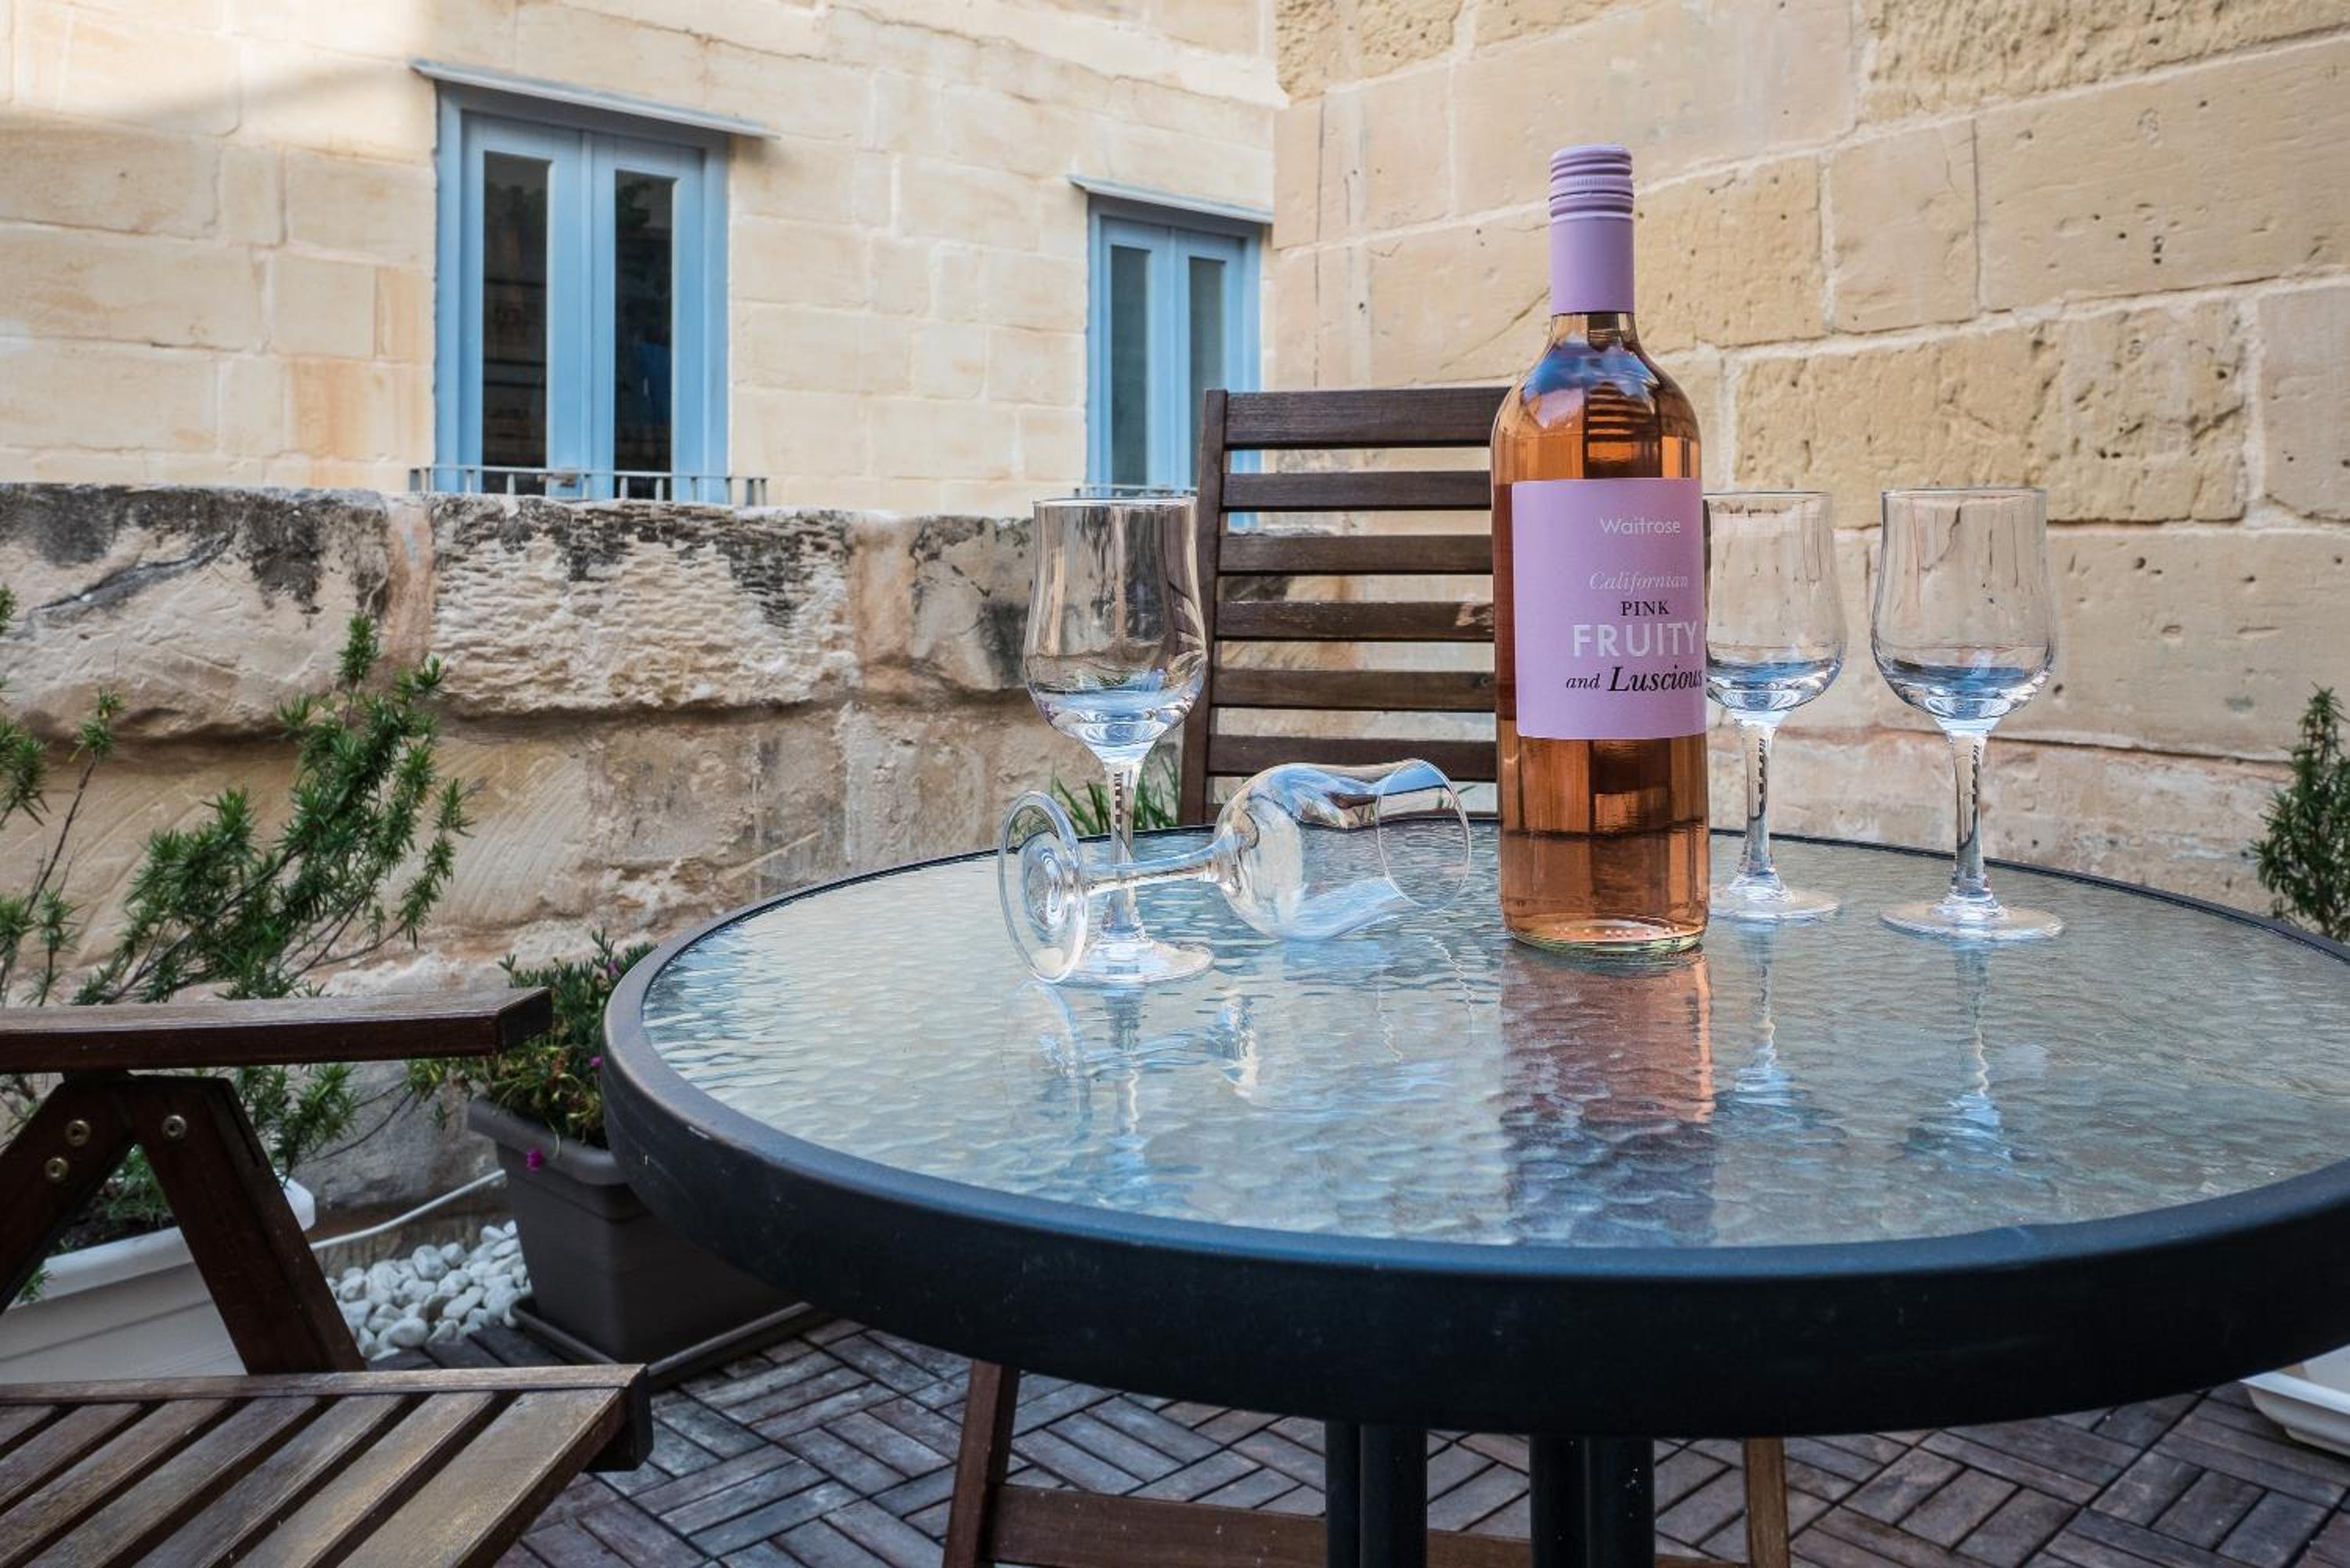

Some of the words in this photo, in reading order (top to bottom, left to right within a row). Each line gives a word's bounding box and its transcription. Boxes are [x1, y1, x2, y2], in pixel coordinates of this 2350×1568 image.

[1600, 518, 1680, 535] Waitrose
[1589, 572, 1688, 594] Californian
[1621, 601, 1670, 616] PINK
[1573, 620, 1697, 657] FRUITY
[1566, 674, 1600, 689] and
[1607, 664, 1702, 692] Luscious
